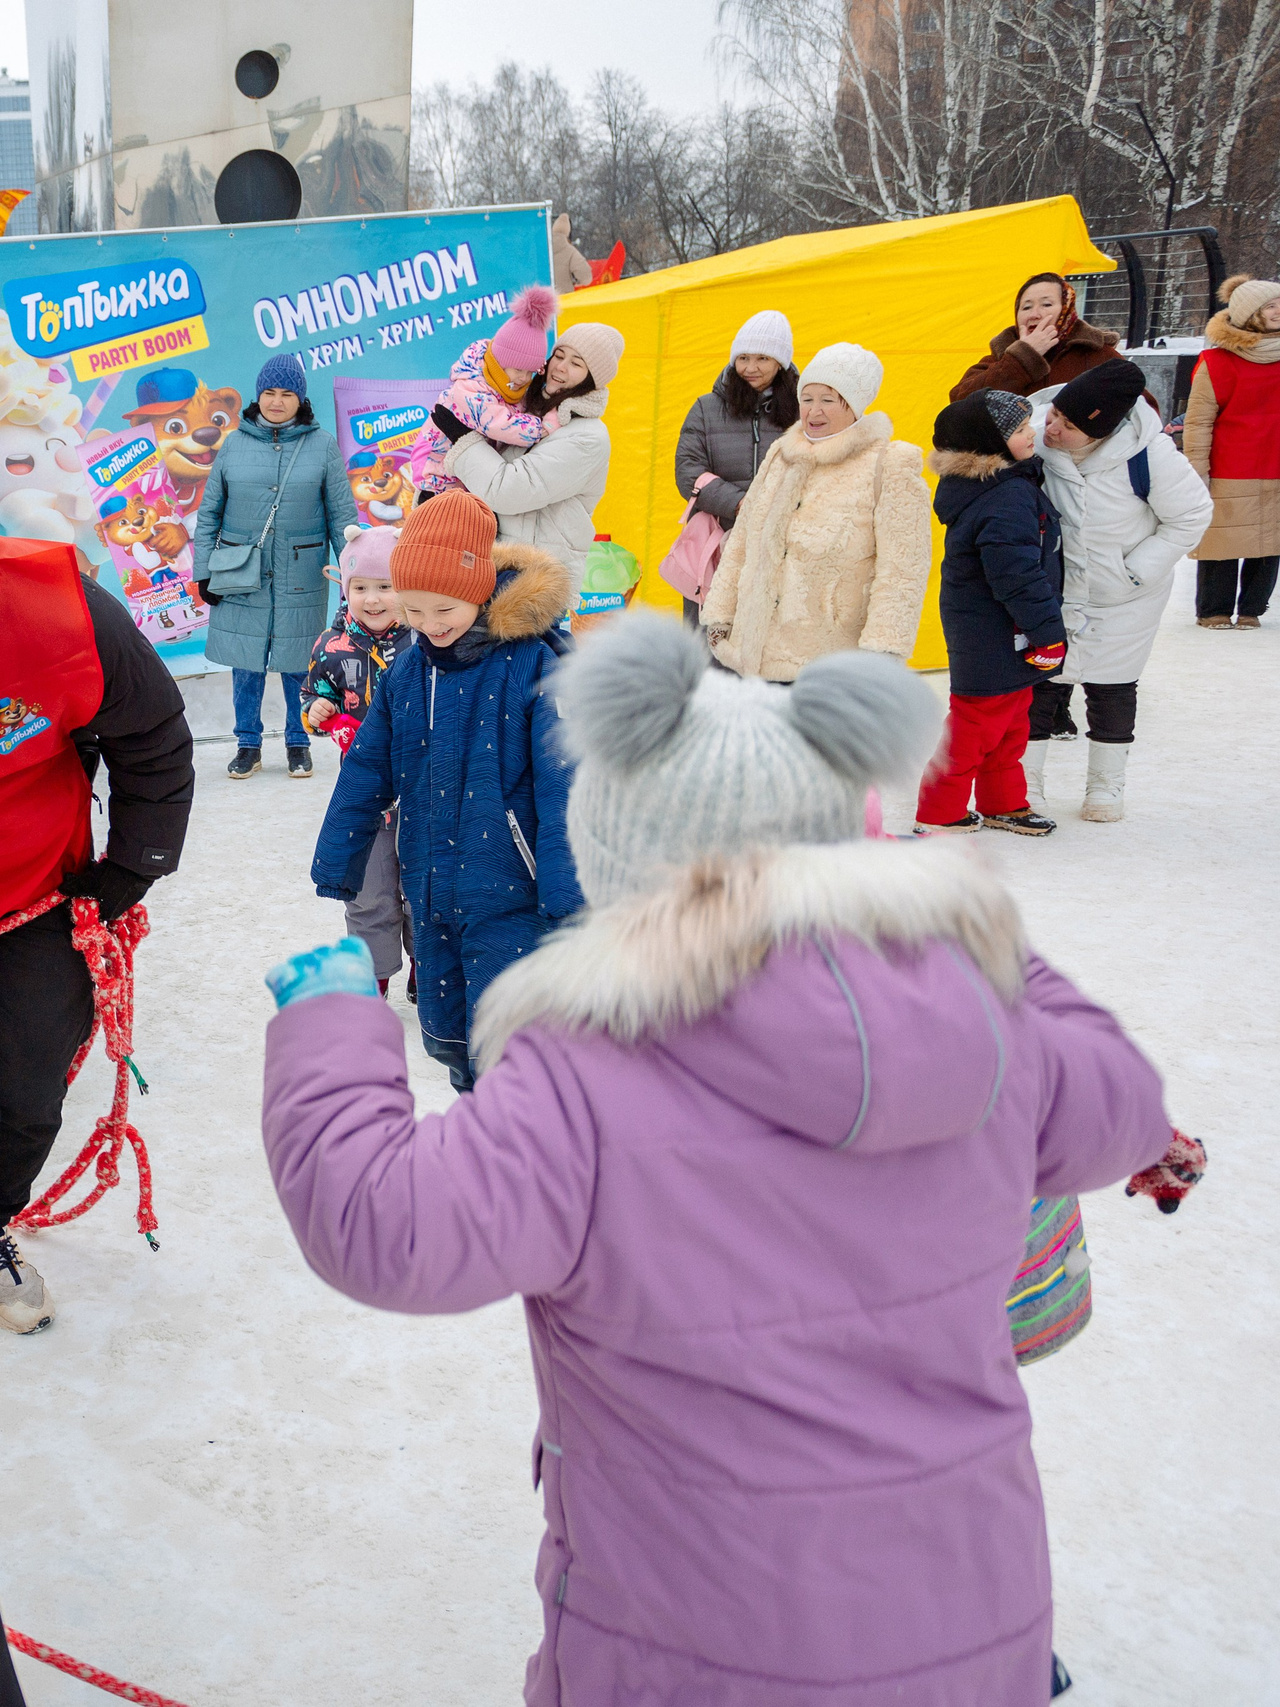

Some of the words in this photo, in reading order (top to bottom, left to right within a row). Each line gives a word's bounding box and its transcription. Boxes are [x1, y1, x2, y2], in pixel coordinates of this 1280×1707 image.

[253, 241, 479, 348] ОМНОМНОМ
[307, 334, 365, 371] ХРУМ
[377, 312, 435, 350] ХРУМ
[447, 290, 508, 329] ХРУМ!
[88, 341, 140, 373] PARTY
[382, 435, 406, 452] PARTY
[407, 431, 421, 443] BO
[121, 467, 140, 485] PARTY
